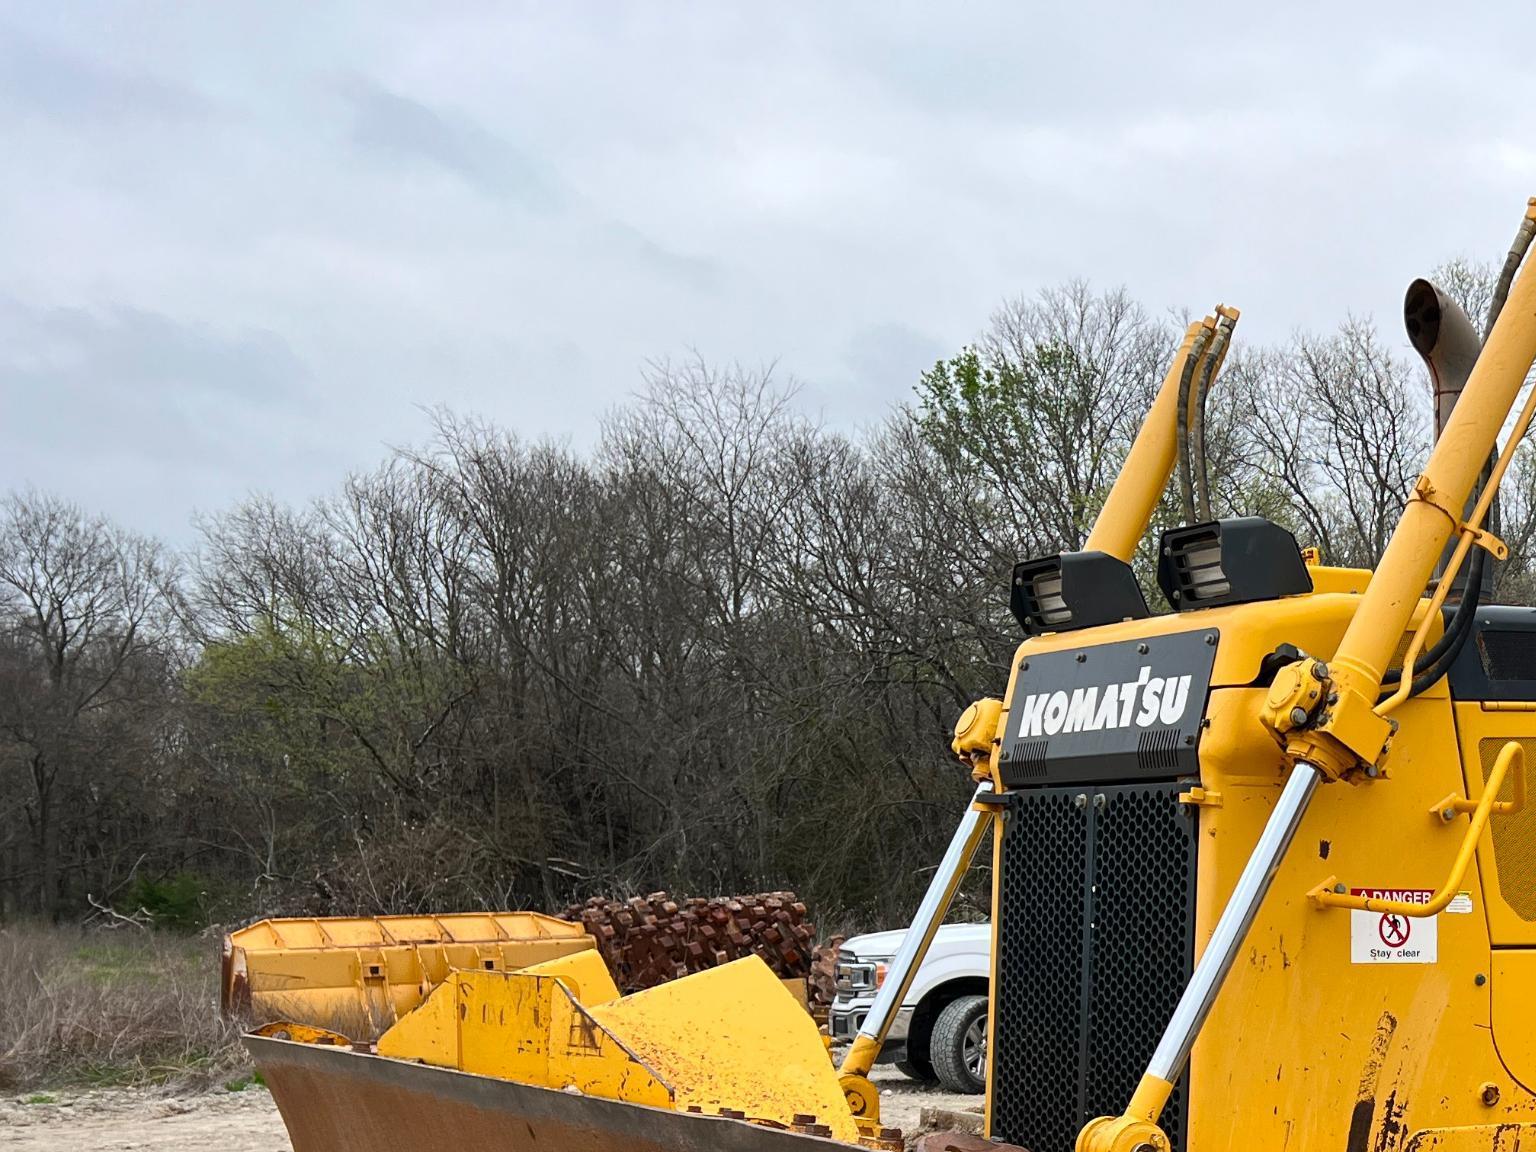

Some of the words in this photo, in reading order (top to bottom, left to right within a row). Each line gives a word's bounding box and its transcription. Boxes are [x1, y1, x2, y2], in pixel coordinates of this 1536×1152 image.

[1018, 666, 1192, 738] KOMATSU
[1370, 949, 1391, 959] Stay
[1397, 949, 1421, 957] clear
